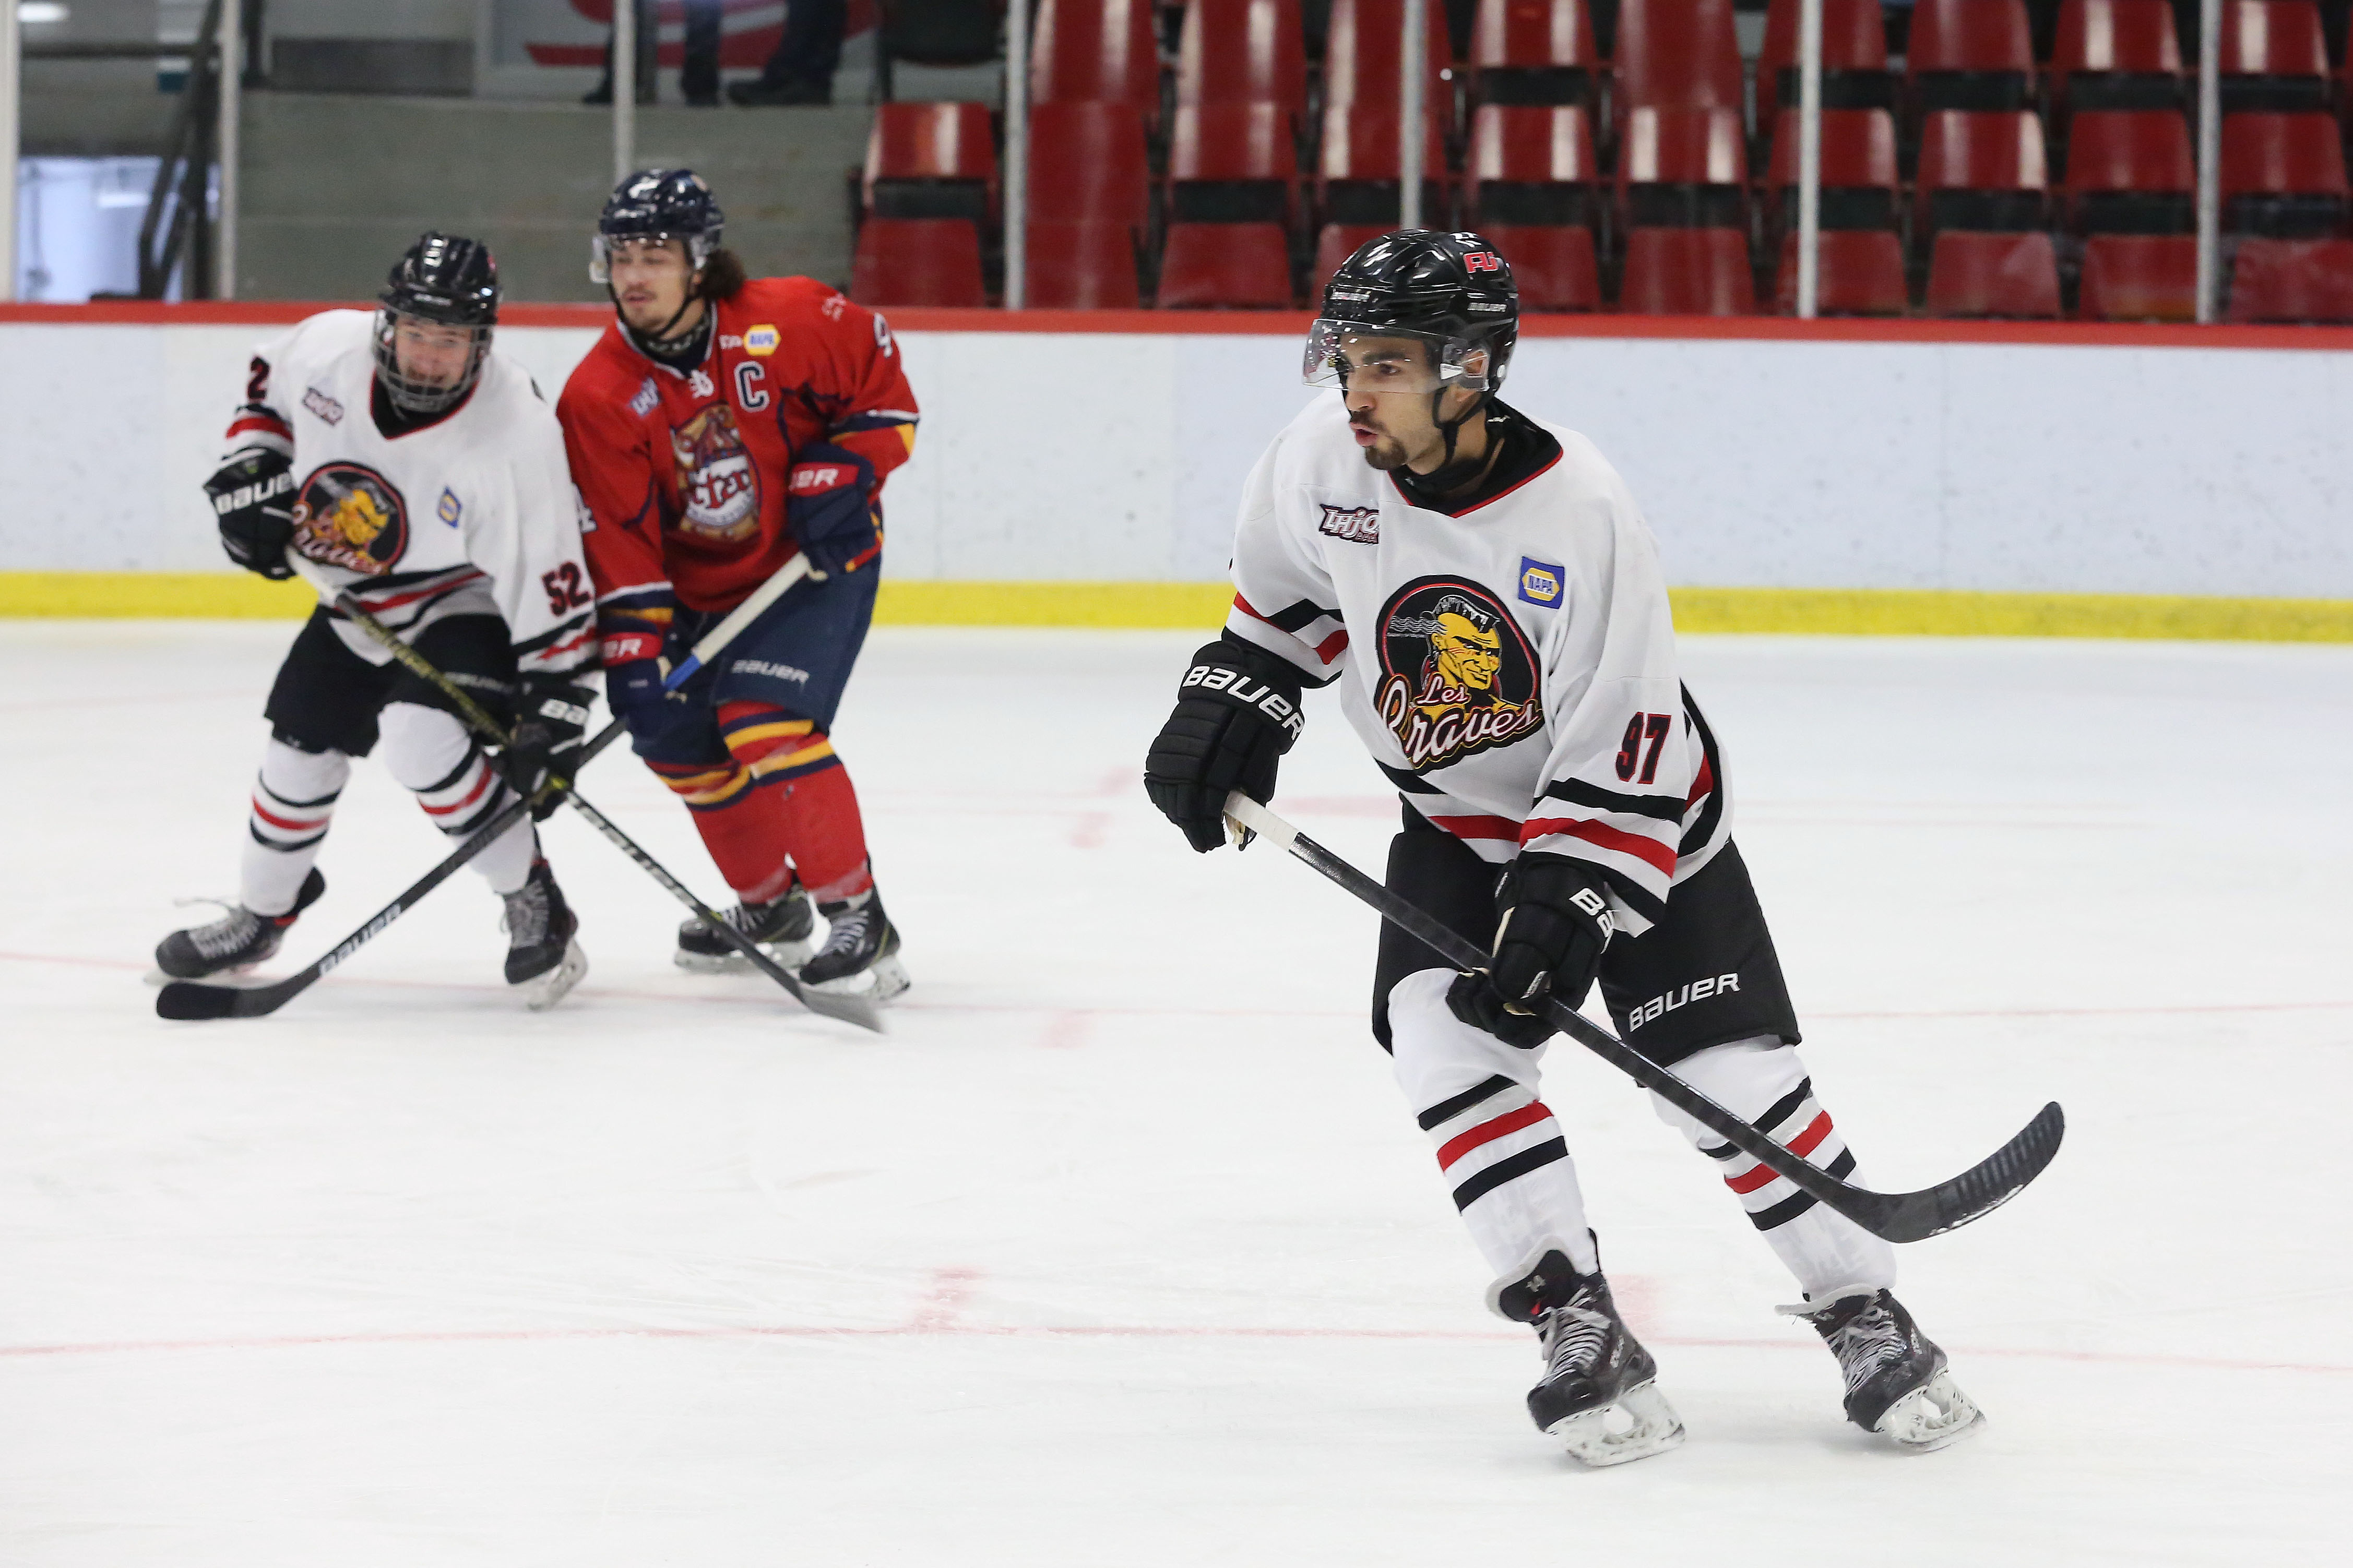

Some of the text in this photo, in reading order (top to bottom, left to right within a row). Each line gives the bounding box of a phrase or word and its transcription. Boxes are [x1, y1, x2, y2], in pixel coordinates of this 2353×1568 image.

[734, 361, 770, 412] C
[541, 562, 590, 616] 52
[1526, 575, 1554, 594] NAPA
[1182, 665, 1305, 740] BAUER
[1416, 675, 1469, 704] Les
[1615, 711, 1672, 784] 97
[1629, 973, 1741, 1033] BAUER
